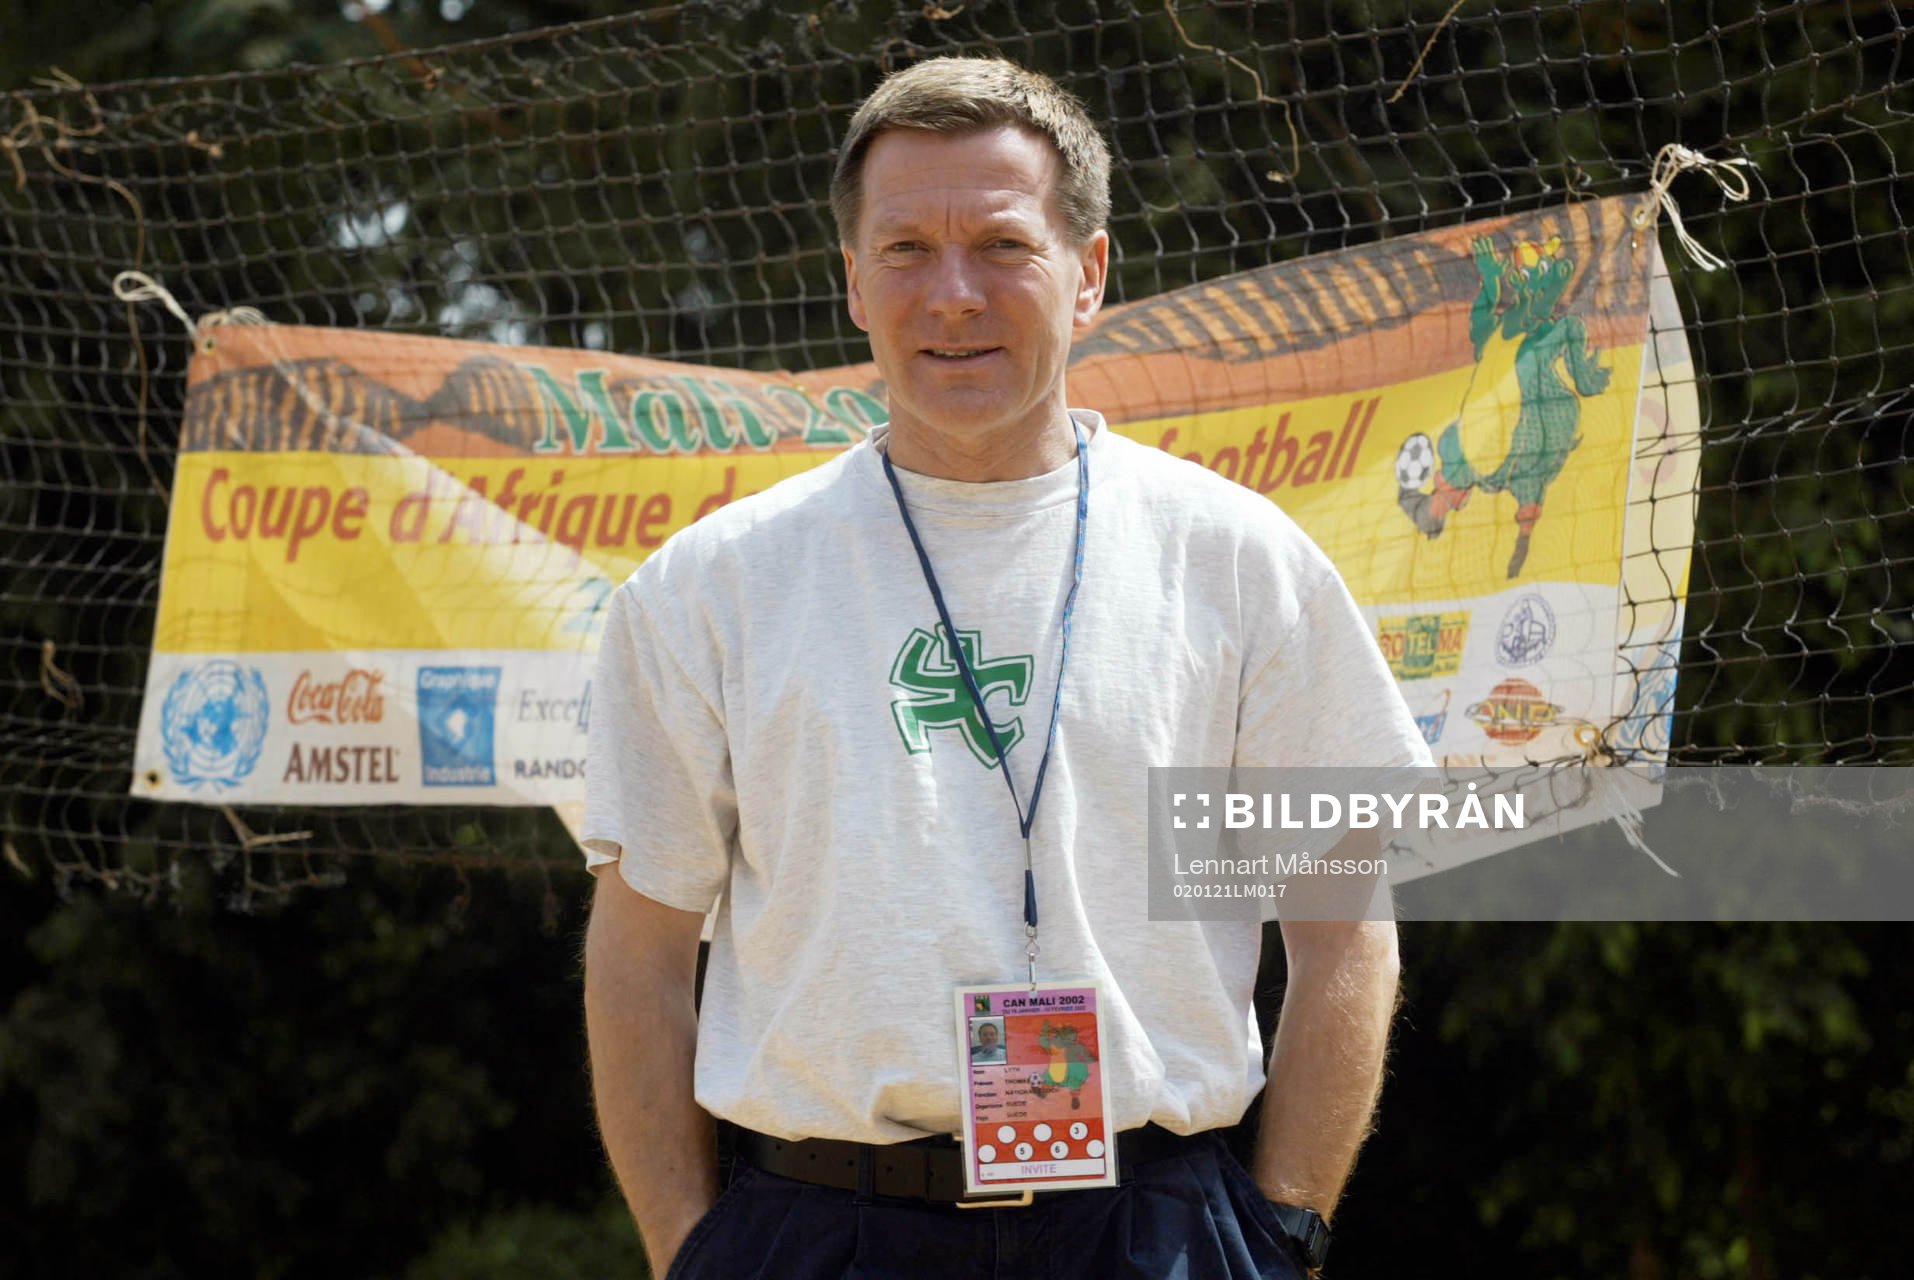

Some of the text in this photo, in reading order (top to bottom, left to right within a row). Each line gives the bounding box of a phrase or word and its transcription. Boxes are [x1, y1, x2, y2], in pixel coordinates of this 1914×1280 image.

[524, 364, 778, 453] Mali
[201, 466, 371, 563] Coupe
[388, 460, 673, 574] d'Afrique
[283, 742, 400, 784] AMSTEL
[1003, 995, 1085, 1008] CAN MALI 2002
[1074, 1126, 1080, 1135] 3
[1020, 1145, 1060, 1156] 5 6
[1021, 1163, 1057, 1176] INVITE
